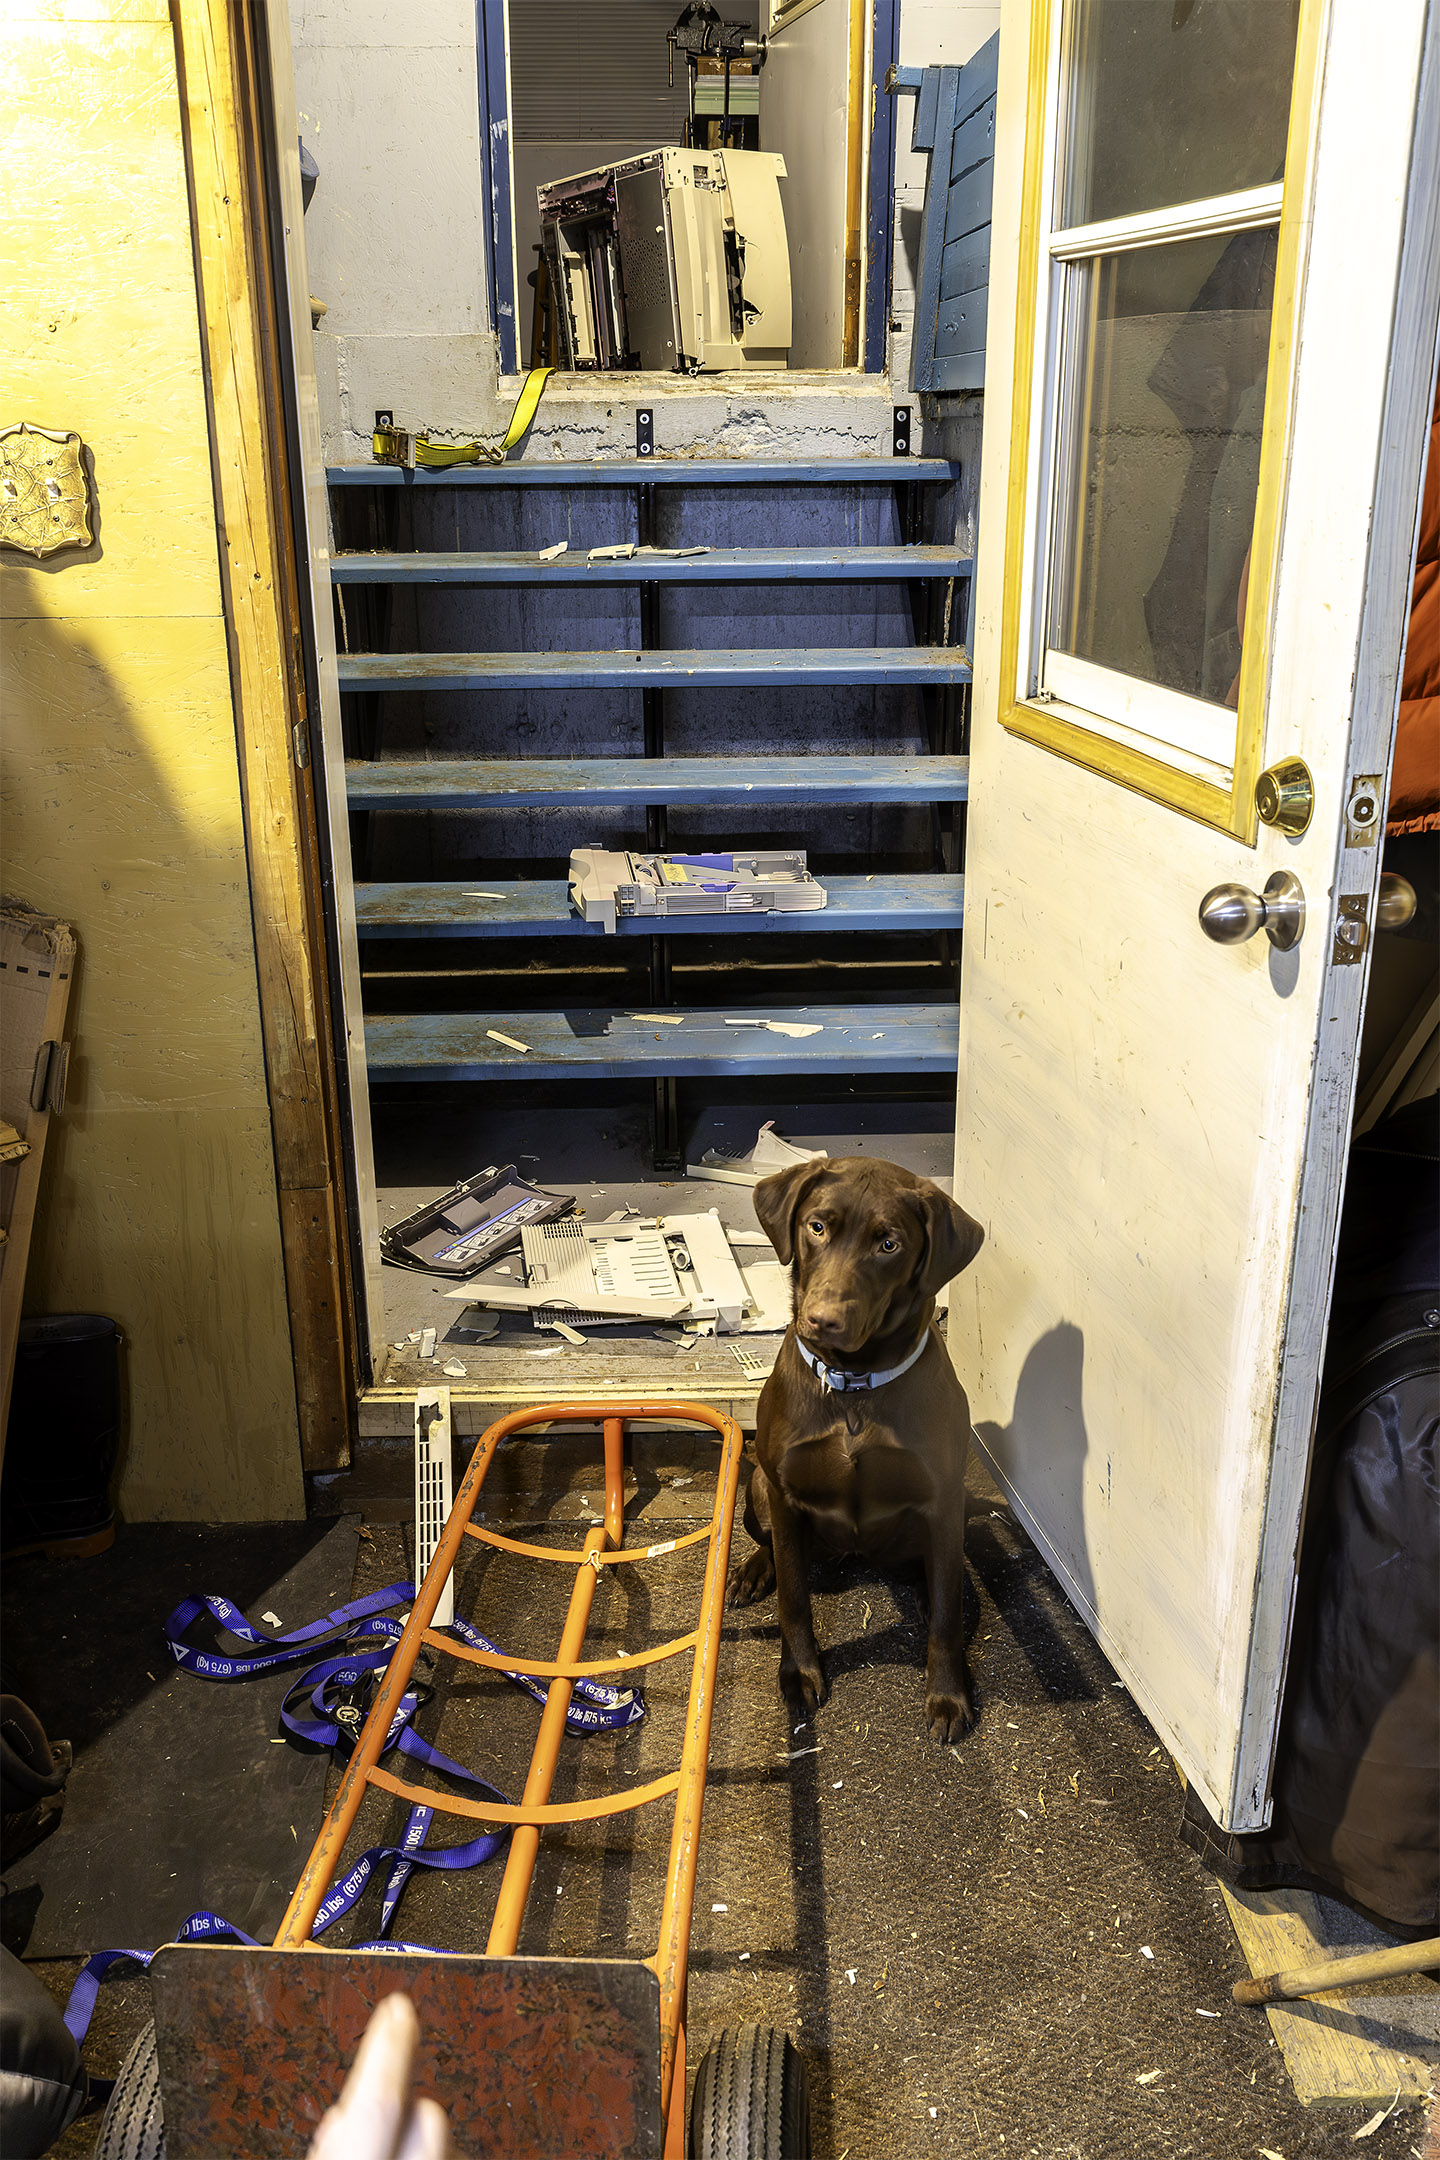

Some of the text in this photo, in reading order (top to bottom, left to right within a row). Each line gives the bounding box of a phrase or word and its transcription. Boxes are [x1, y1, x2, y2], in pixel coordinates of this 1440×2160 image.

[195, 1655, 210, 1668] kg)
[210, 1662, 232, 1675] (675
[406, 1824, 424, 1846] 1500
[324, 1895, 346, 1914] lbs
[342, 1871, 363, 1898] (675
[357, 1857, 372, 1874] kg)
[191, 1917, 211, 1932] lbs
